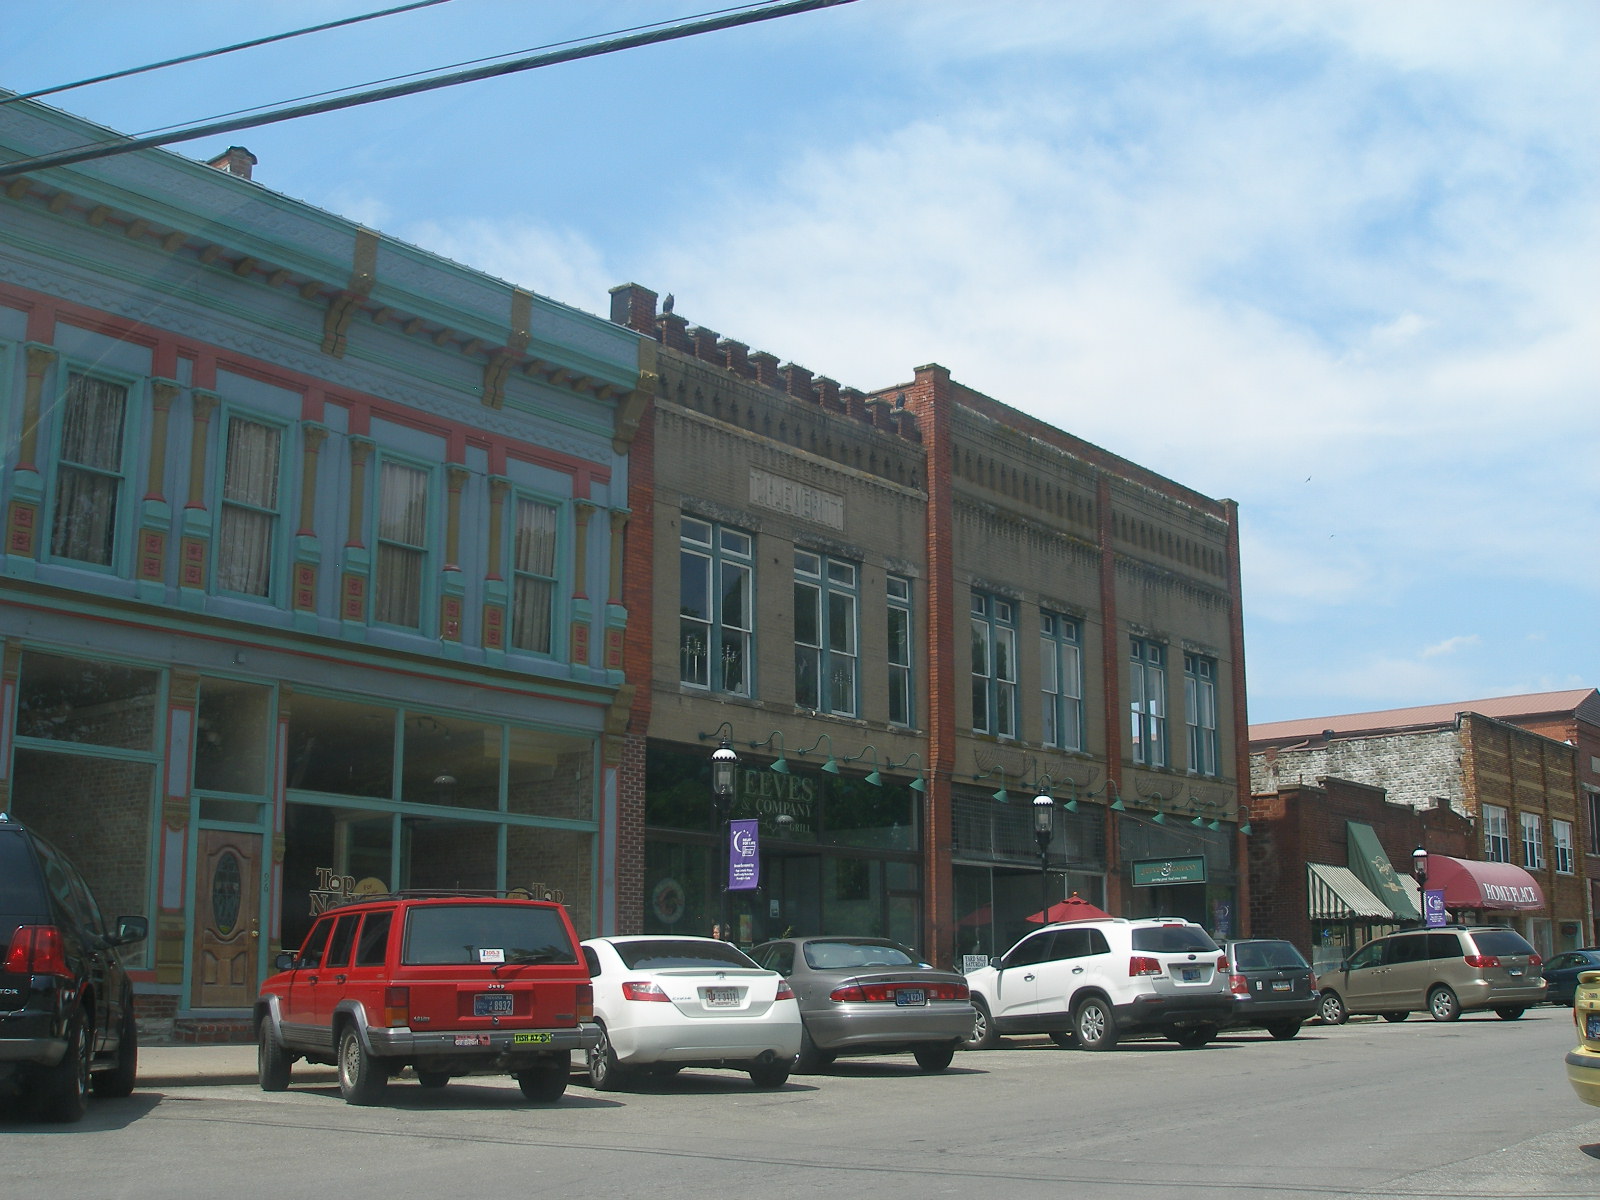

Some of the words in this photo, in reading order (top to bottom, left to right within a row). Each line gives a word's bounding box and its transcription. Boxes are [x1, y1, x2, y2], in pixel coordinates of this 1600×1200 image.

[744, 769, 814, 802] EEVES
[755, 798, 811, 817] COMPANY
[315, 866, 356, 899] Top
